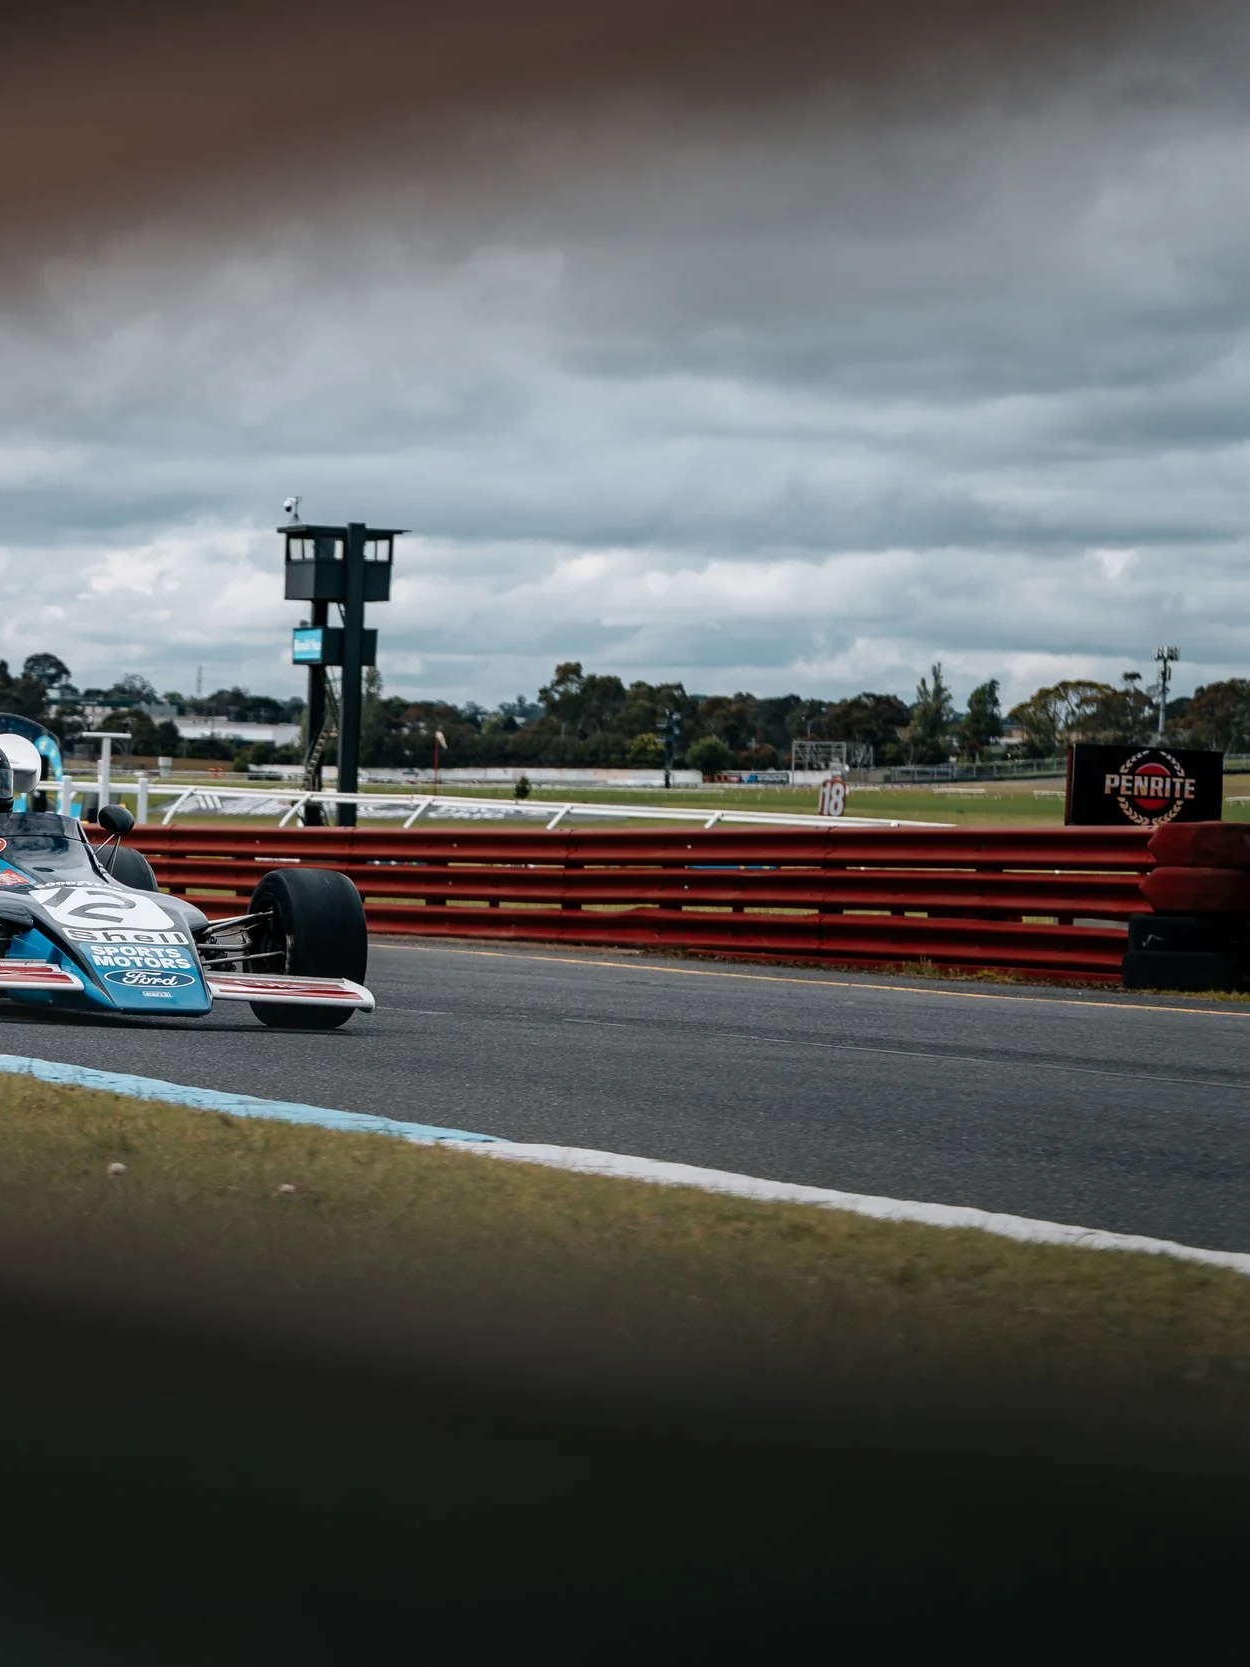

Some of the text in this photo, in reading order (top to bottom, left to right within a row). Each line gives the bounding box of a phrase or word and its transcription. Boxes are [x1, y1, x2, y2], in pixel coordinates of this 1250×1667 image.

[1104, 774, 1196, 799] PENRITE
[823, 782, 845, 817] 18
[41, 887, 137, 923] 12
[67, 929, 185, 944] Shell
[90, 945, 182, 959] SPORTS
[91, 954, 192, 969] MOTORS
[122, 971, 179, 986] Ford
